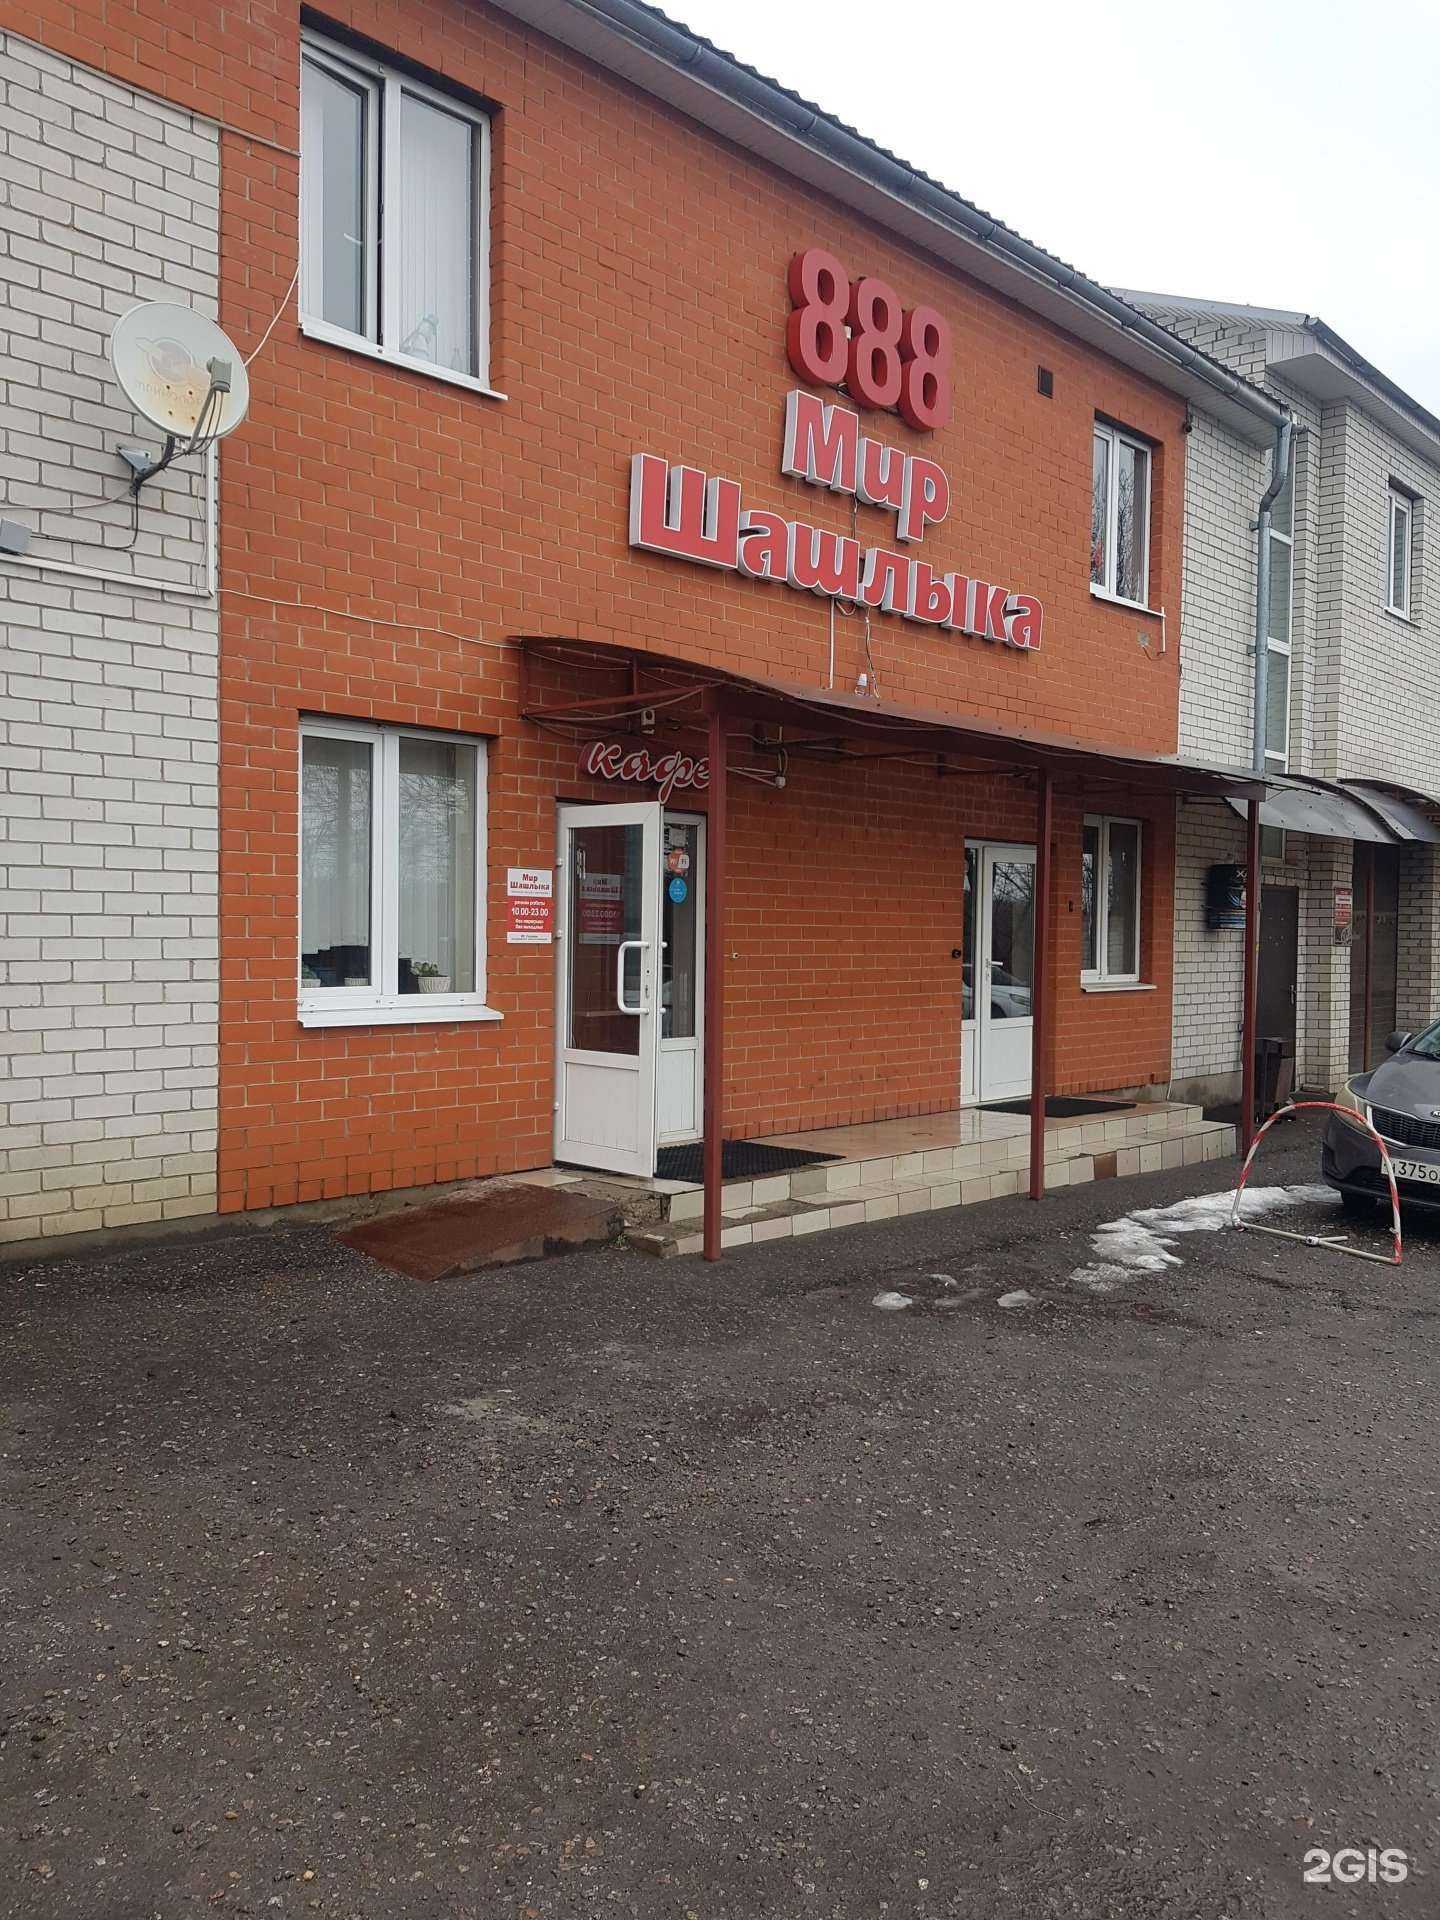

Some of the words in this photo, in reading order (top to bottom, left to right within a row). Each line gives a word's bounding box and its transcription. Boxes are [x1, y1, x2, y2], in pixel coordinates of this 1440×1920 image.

[787, 248, 952, 431] 888
[782, 389, 950, 542] Мир
[630, 452, 1044, 650] Шашлыка
[510, 881, 550, 891] Шашлыка
[522, 873, 538, 883] Мир
